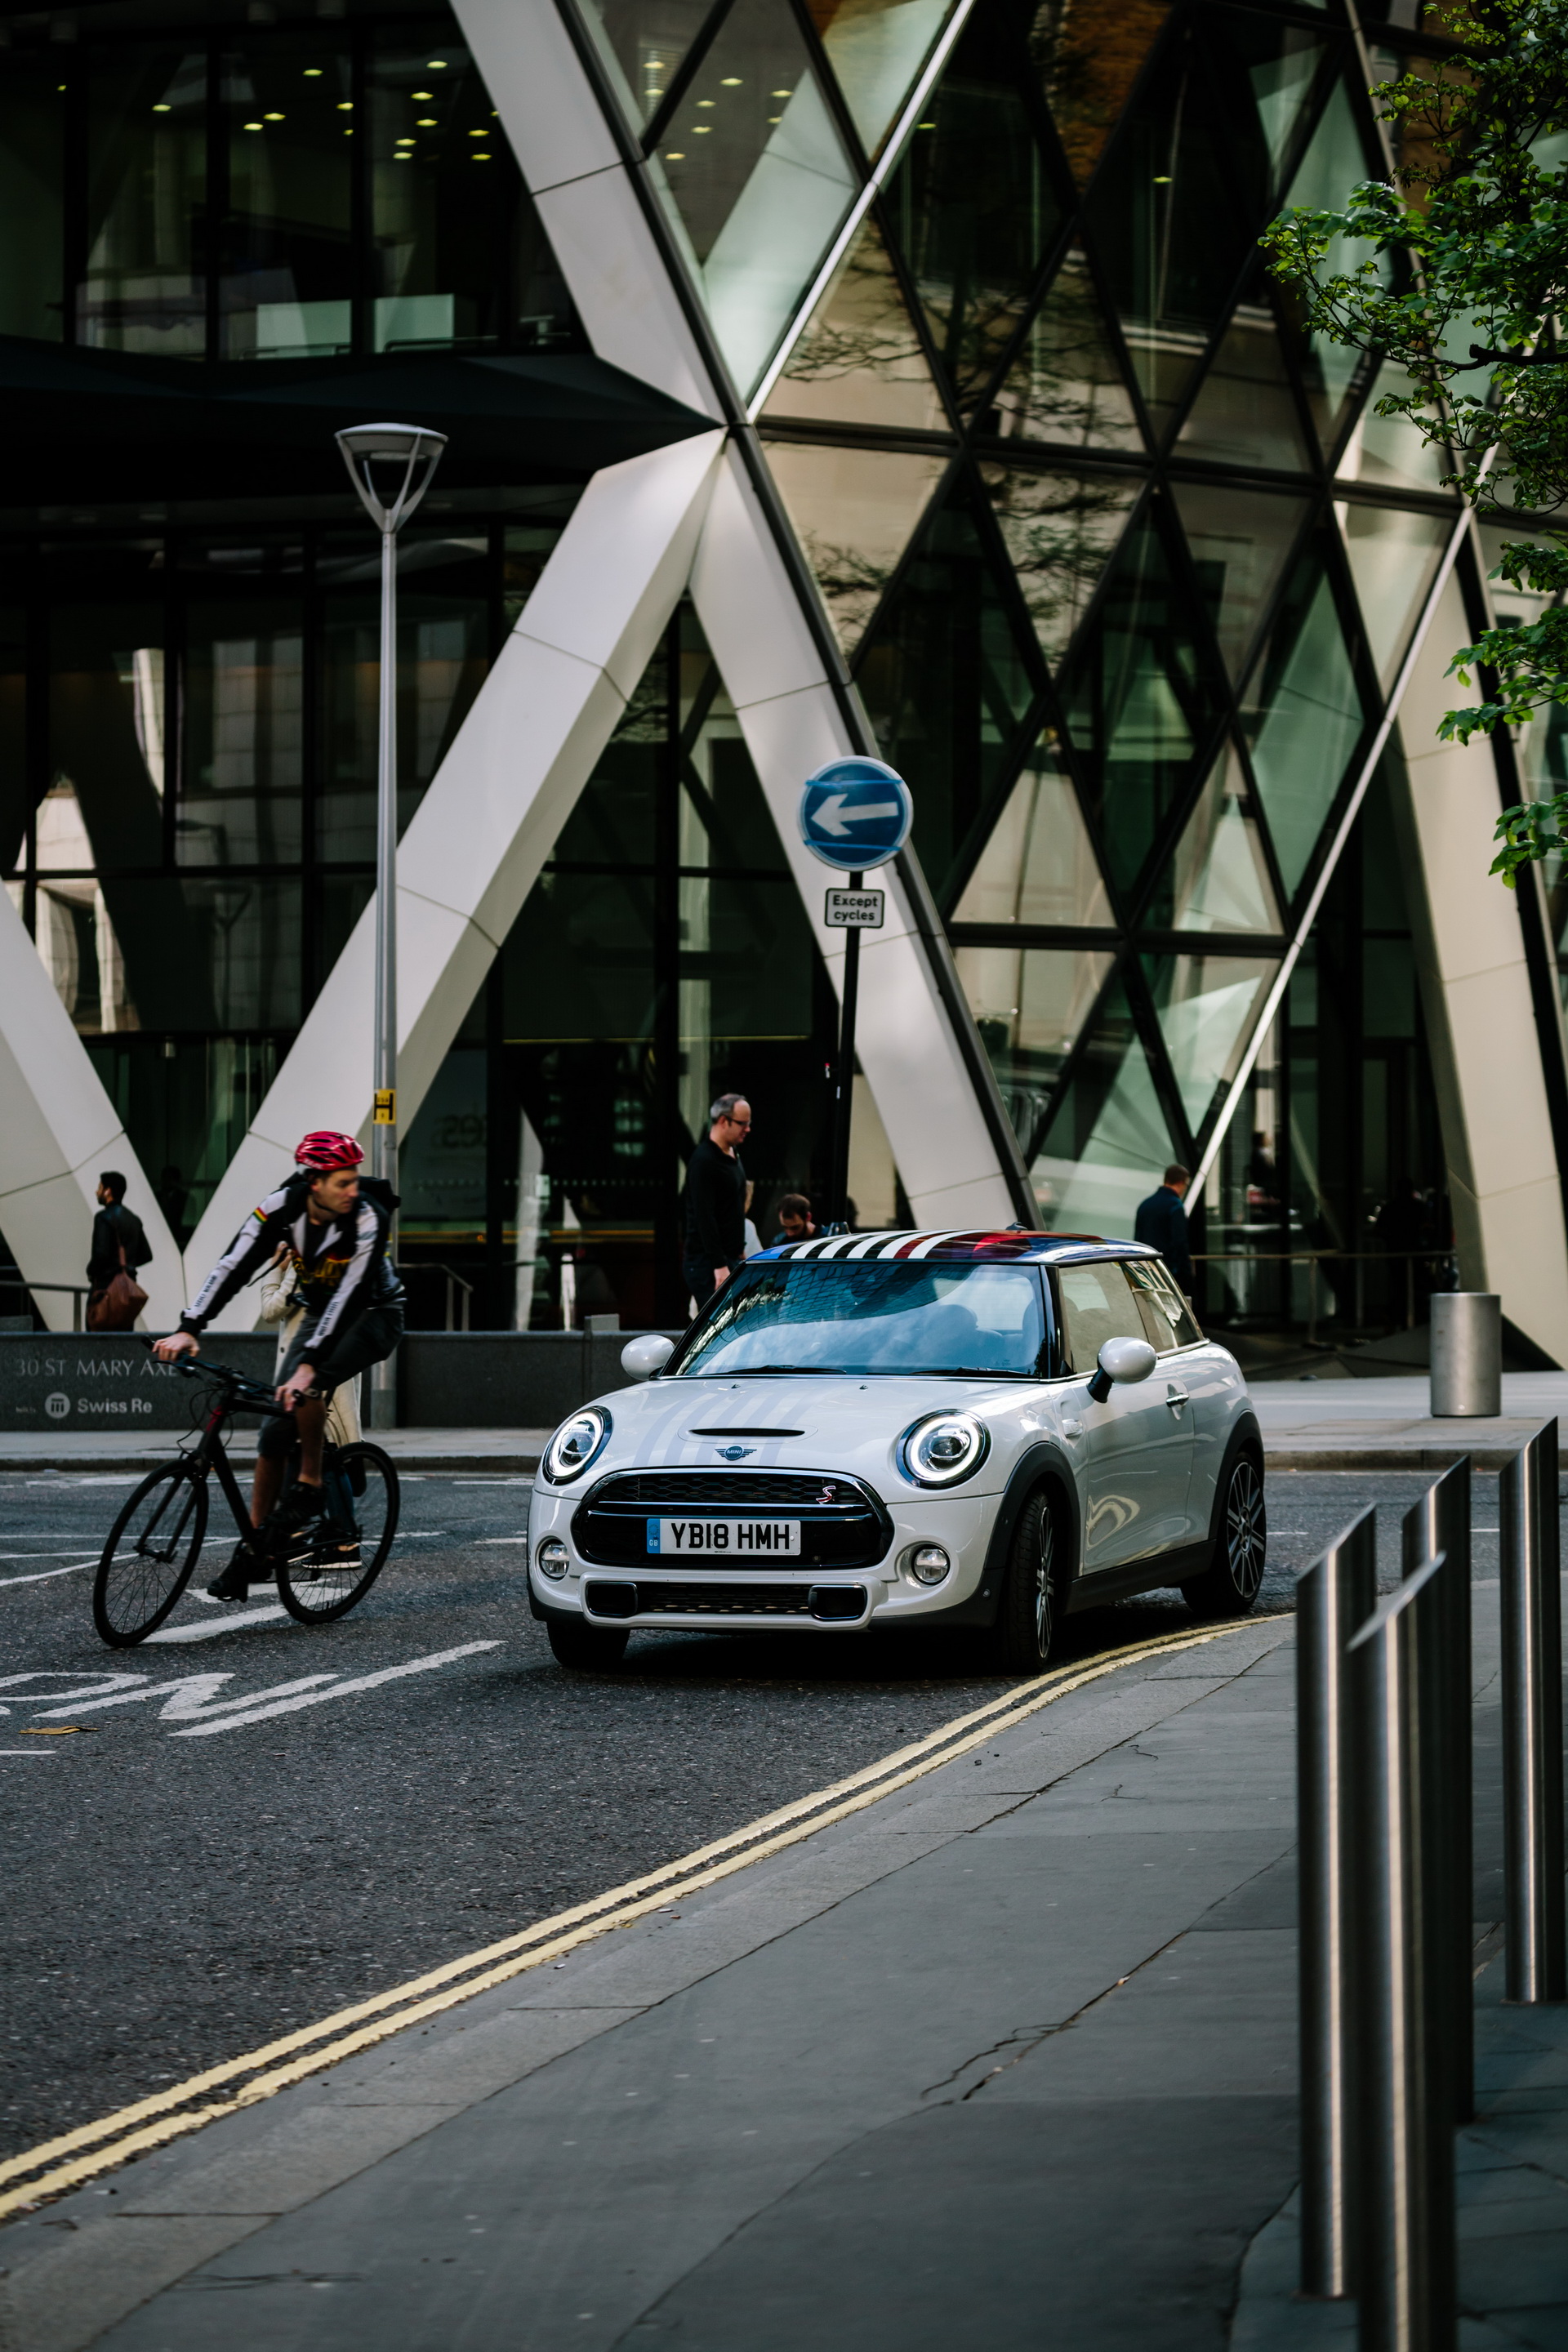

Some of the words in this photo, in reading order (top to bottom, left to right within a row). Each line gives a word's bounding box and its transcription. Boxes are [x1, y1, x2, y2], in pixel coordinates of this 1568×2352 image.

[833, 895, 878, 907] Except
[834, 910, 875, 921] cycles
[373, 1092, 394, 1120] H
[16, 1359, 39, 1377] 30
[45, 1358, 67, 1377] ST
[77, 1359, 134, 1377] MARY
[140, 1359, 178, 1377] AXE
[78, 1398, 127, 1413] Swiss
[131, 1398, 153, 1413] Re
[670, 1522, 729, 1549] YB18
[737, 1523, 790, 1550] HMH
